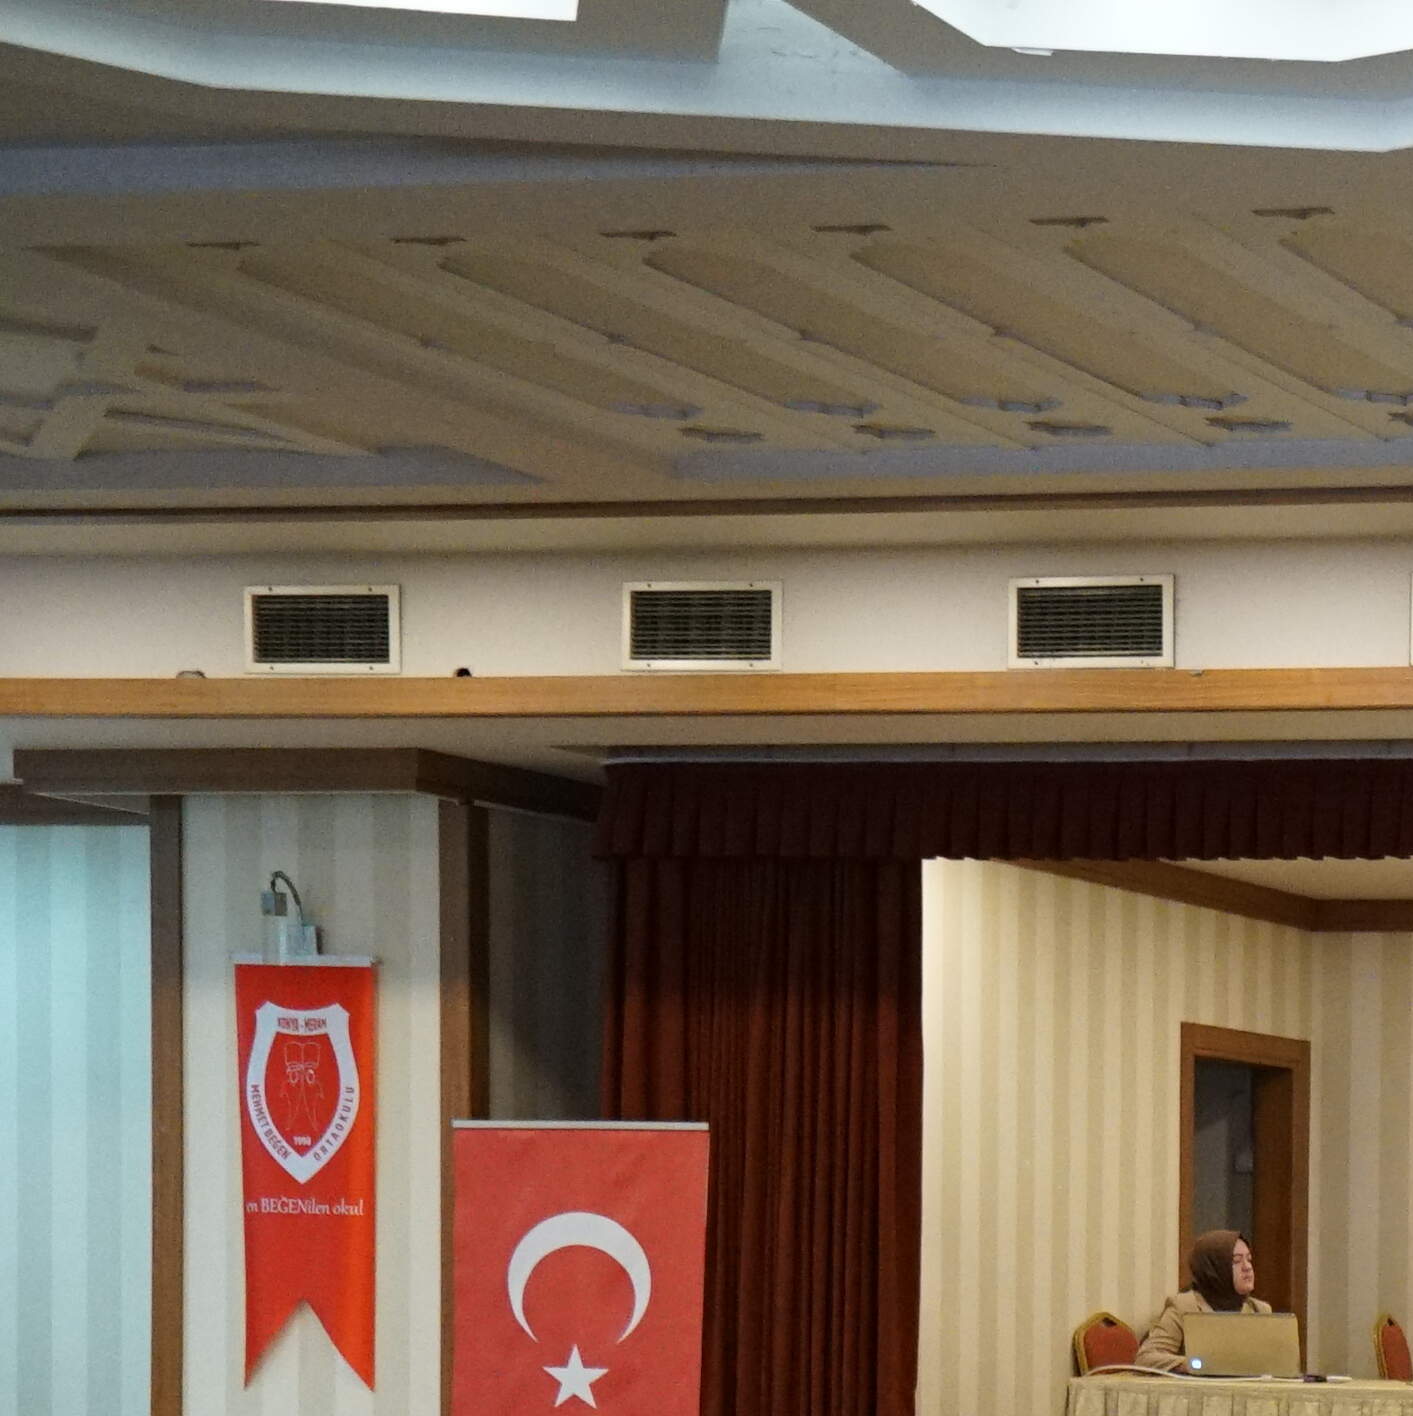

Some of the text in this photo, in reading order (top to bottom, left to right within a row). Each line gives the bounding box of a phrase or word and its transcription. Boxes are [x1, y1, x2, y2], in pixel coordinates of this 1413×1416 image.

[250, 1084, 269, 1129] MEHMET
[313, 1086, 355, 1161] ORTAOKULU
[333, 1199, 364, 1216] okul
